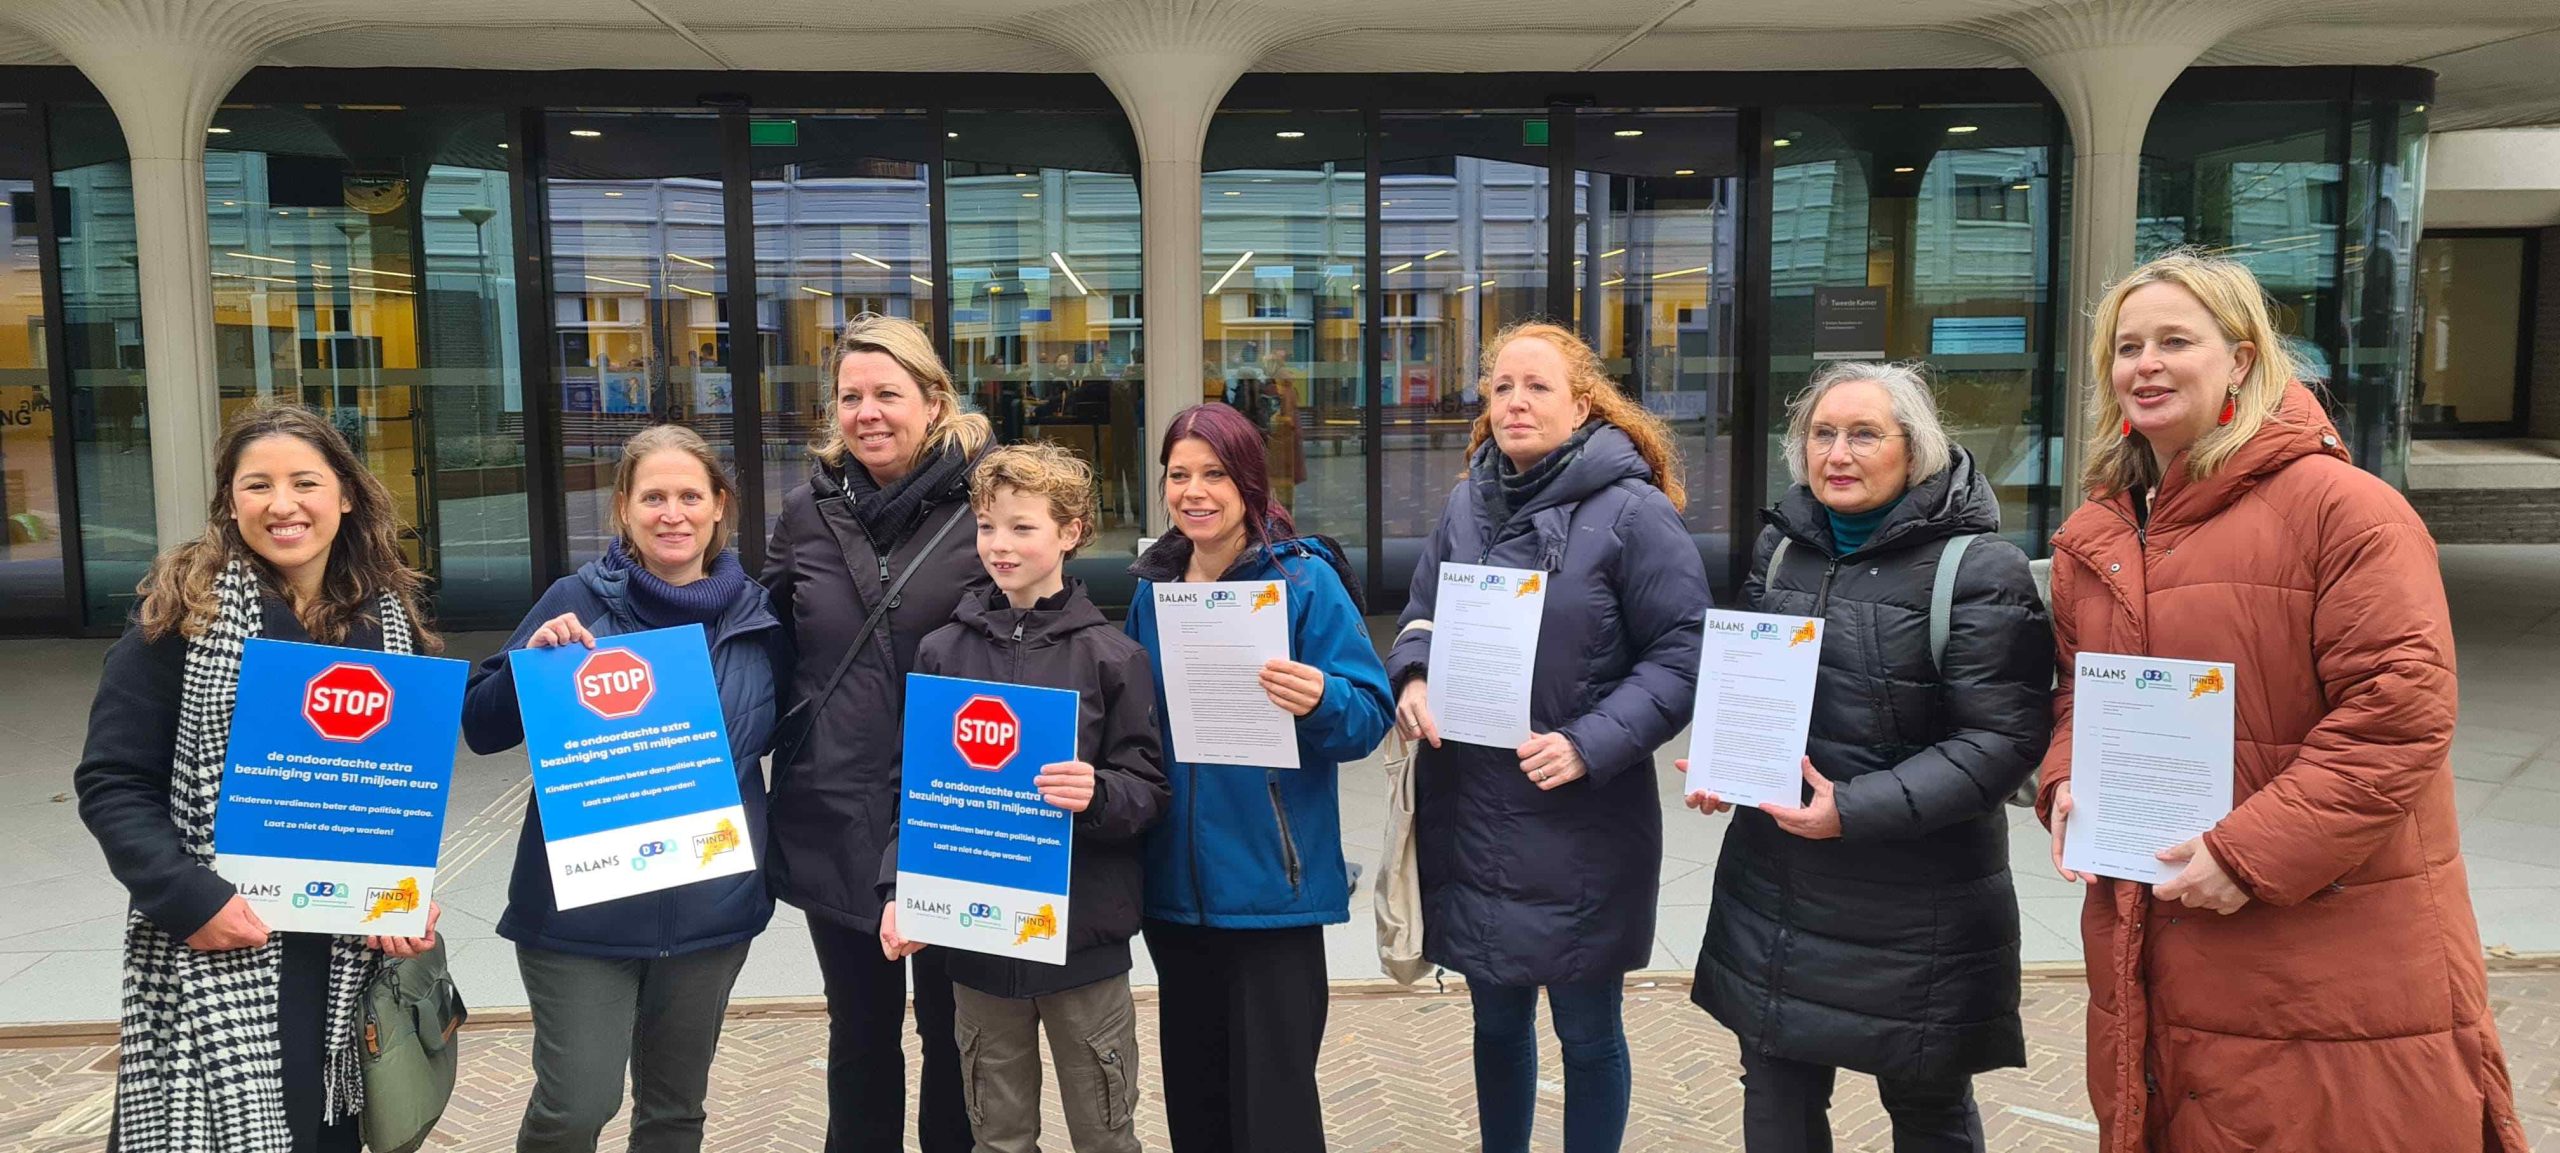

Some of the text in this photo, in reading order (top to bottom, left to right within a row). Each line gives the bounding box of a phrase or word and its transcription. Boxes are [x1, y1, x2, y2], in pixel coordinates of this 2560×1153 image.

[1444, 573, 1475, 583] BALANS
[1159, 593, 1197, 602] BALANS
[1709, 620, 1744, 632] BALANS
[584, 668, 645, 697] STOP
[2081, 666, 2126, 680] BALANS
[313, 687, 384, 716] STOP
[564, 721, 690, 749] de ondoordachte extra
[960, 719, 1014, 746] STOP
[267, 752, 412, 772] de ondoordachte extra
[541, 731, 717, 768] bezuiniging van 511 miljoen euro
[235, 764, 438, 790] bezuiniging van 511 miljoen euro
[545, 756, 723, 794] Kinderen verdienen beter dan politiek gedoe.
[583, 799, 601, 807] Laat
[613, 793, 629, 802] niet
[630, 791, 640, 799] de
[641, 787, 662, 797] dupe
[663, 780, 696, 793] worden!
[931, 779, 1041, 801] de ondoordachte extra
[229, 795, 434, 817] Kinderen verdienen beter dan politiek gedoe.
[909, 790, 1063, 818] bezuiniging van 511 miljoen euro
[264, 820, 285, 828] Laat
[298, 821, 316, 830] niet
[318, 823, 329, 831] de
[331, 824, 355, 834] dupe
[357, 826, 394, 836] worden!
[907, 818, 1061, 846] Kinderen verdienen beter dan politiek gedoe.
[565, 855, 620, 876] BALANS
[696, 833, 726, 846] MIND
[934, 842, 949, 850] Laat
[958, 846, 972, 854] niet
[983, 849, 1001, 859] dupe
[1003, 852, 1031, 862] worden!
[234, 883, 281, 896] LANS
[370, 891, 403, 900] MIND
[907, 898, 951, 915] BALANS
[1018, 915, 1044, 927] MIND
